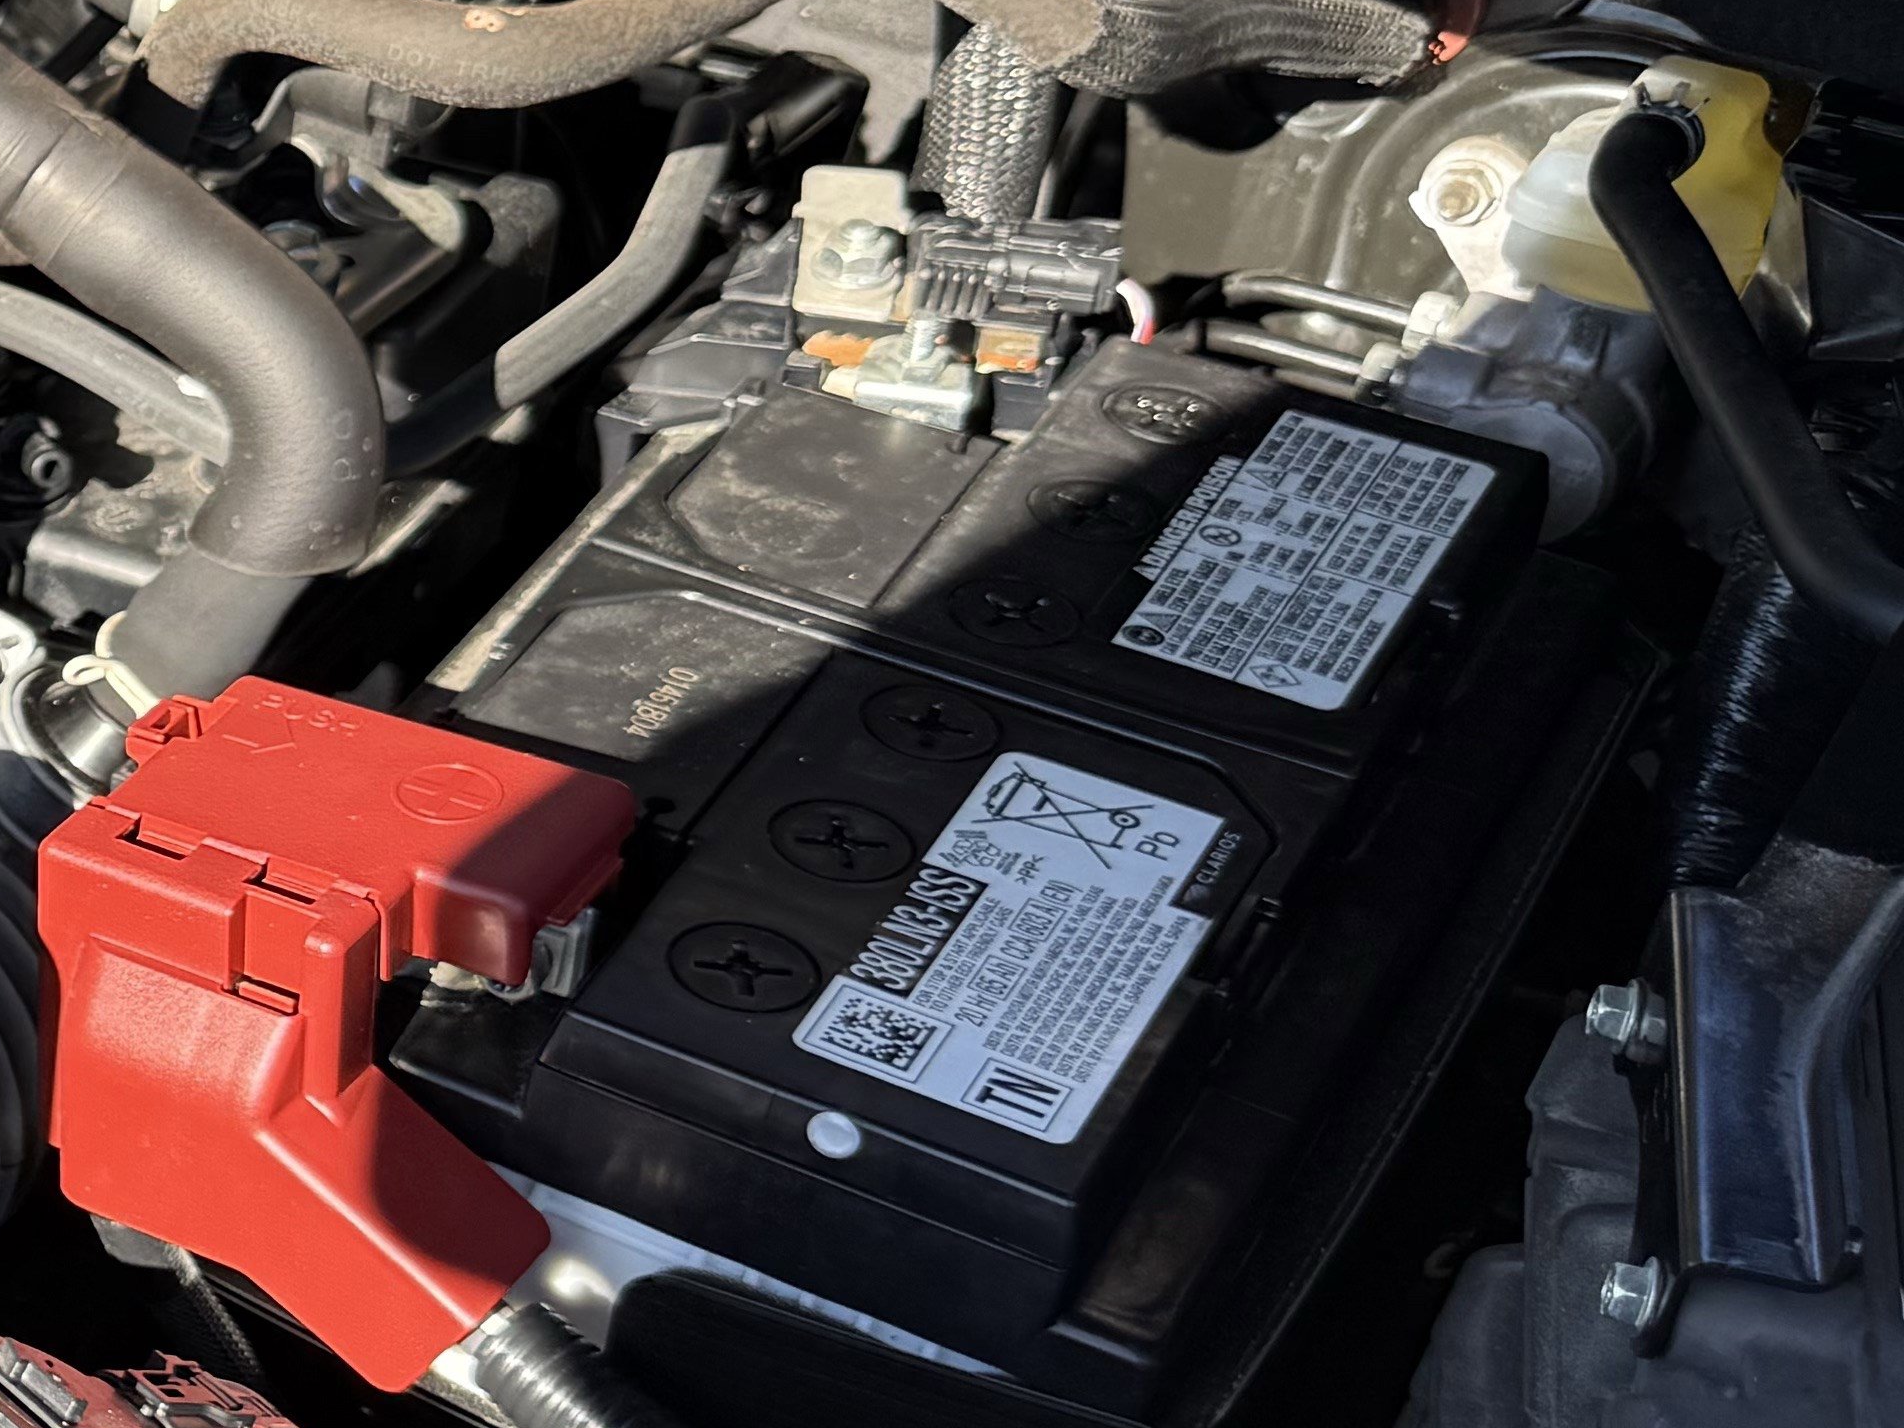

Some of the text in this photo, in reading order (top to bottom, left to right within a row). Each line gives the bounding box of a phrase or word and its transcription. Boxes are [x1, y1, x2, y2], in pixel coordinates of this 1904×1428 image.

[1135, 832, 1180, 861] Pb
[1196, 831, 1242, 884] CLARIOS
[850, 865, 982, 993] 380LN3-ISS
[987, 905, 1013, 928] CARS
[942, 939, 970, 964] START
[952, 876, 1076, 1027] 20 Hr 65 Ah CCA 603 A (EN)
[923, 969, 948, 990] STOP
[936, 974, 966, 1002] OTHER
[912, 989, 935, 1007] FOR
[928, 999, 949, 1013] TO
[975, 1066, 1061, 1124] TN
